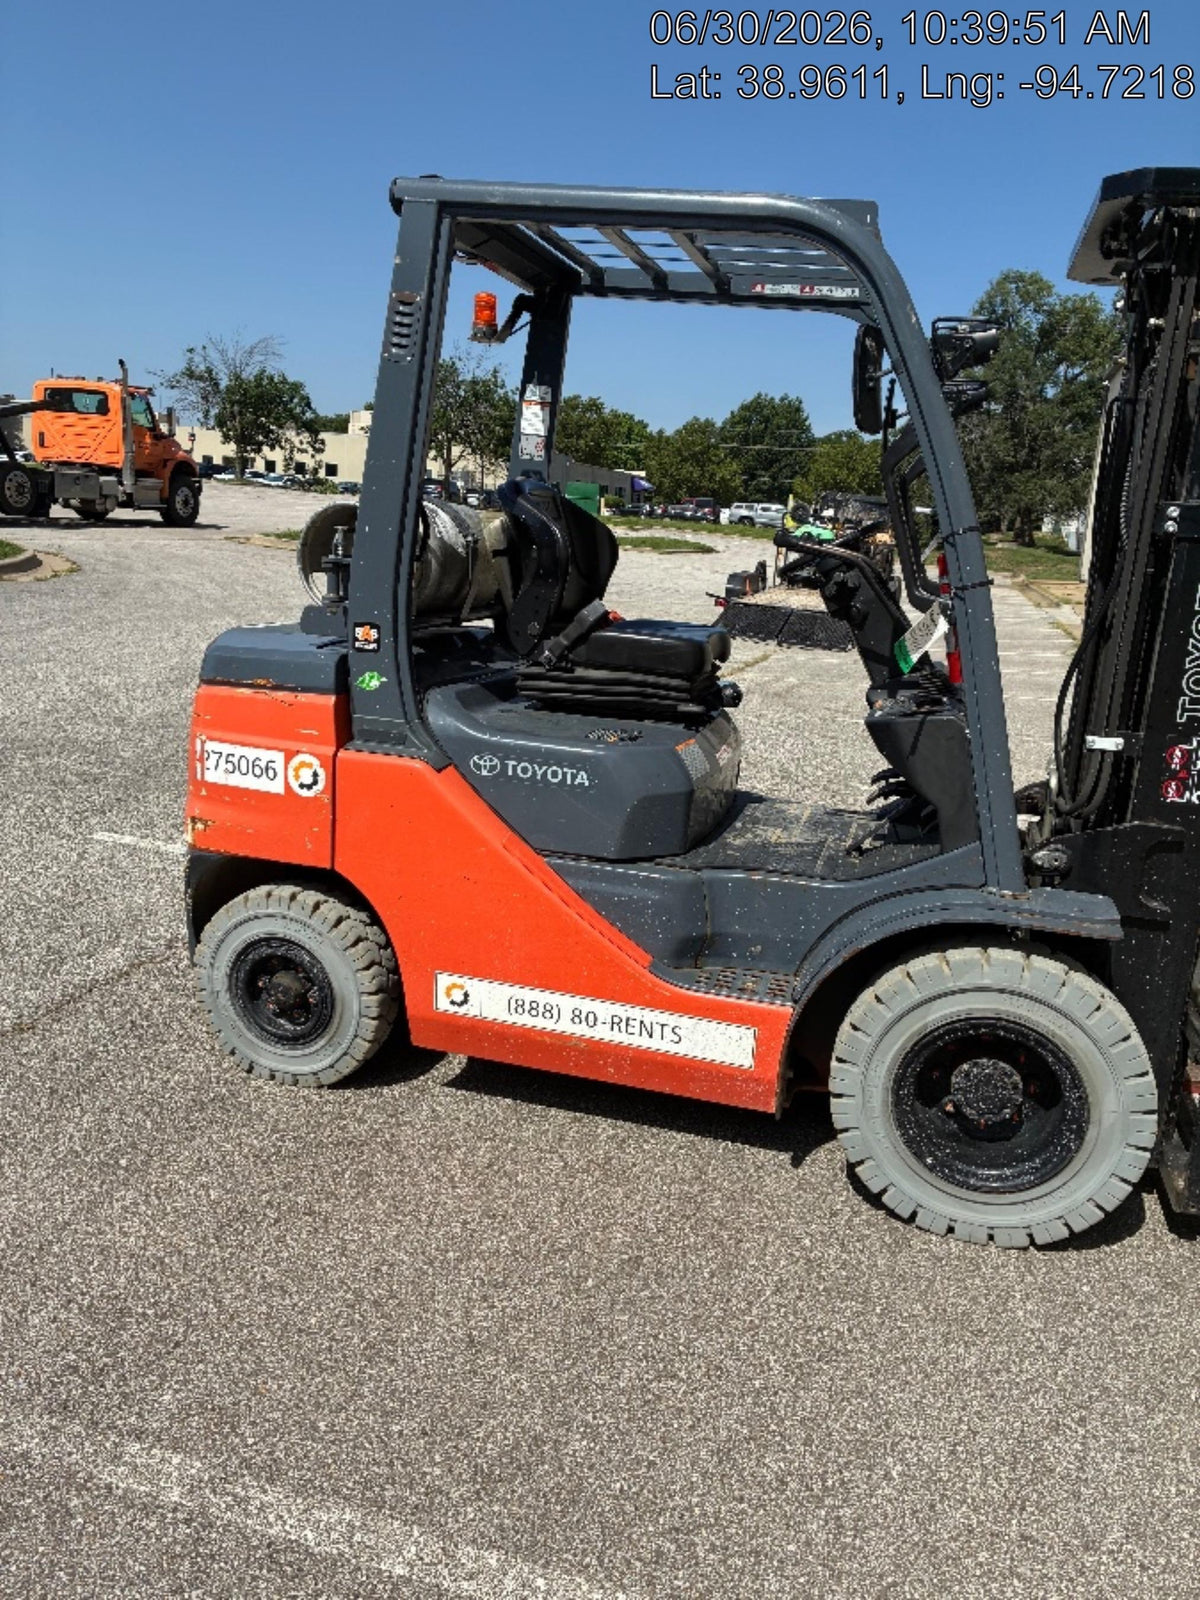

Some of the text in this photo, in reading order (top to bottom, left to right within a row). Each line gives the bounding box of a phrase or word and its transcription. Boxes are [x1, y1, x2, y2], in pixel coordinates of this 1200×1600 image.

[504, 760, 589, 786] TOYOTA
[507, 996, 682, 1045] (888) 80-RENTS
